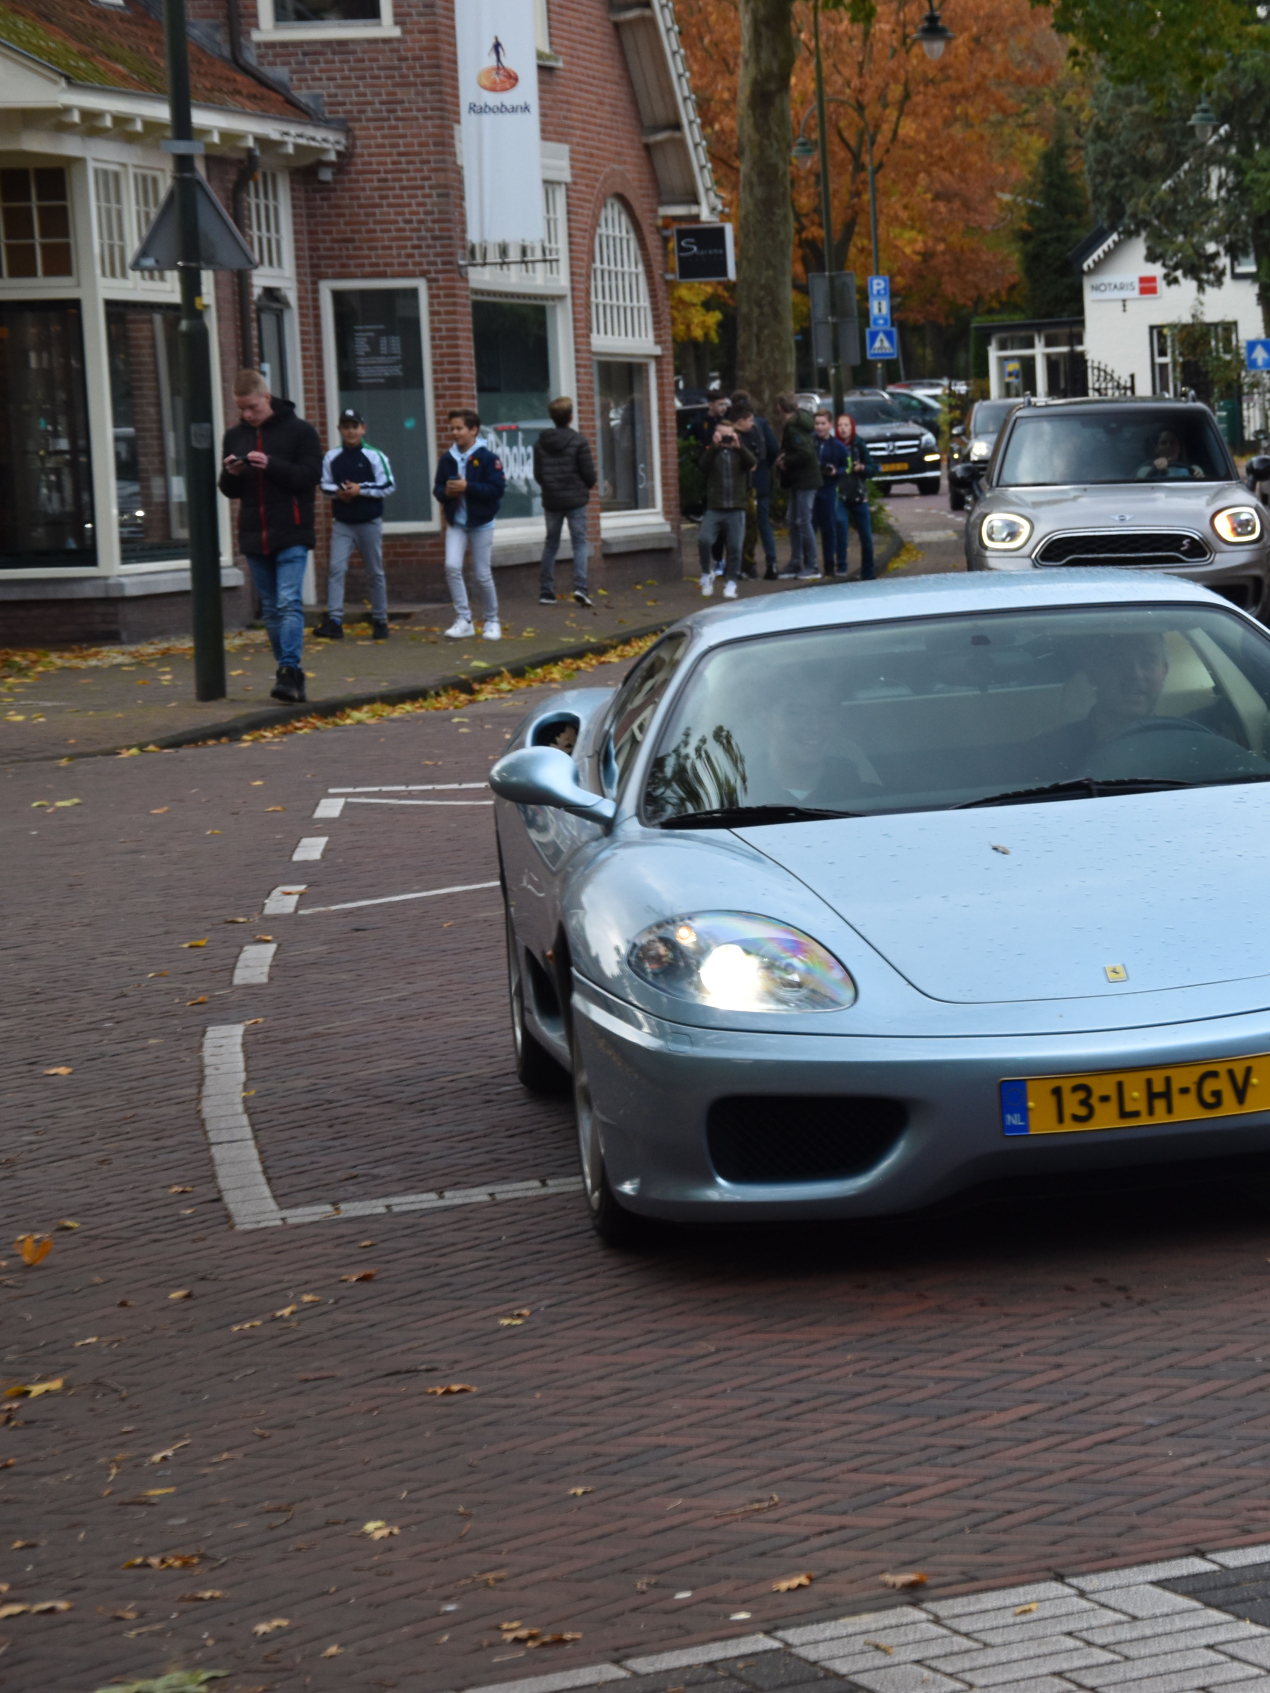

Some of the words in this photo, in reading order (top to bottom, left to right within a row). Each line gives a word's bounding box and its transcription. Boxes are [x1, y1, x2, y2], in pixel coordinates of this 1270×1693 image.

[468, 101, 531, 114] Rabobank
[1090, 282, 1135, 292] NOTARIS
[1050, 1066, 1253, 1124] 13-LH-GV
[1005, 1113, 1025, 1126] NL
